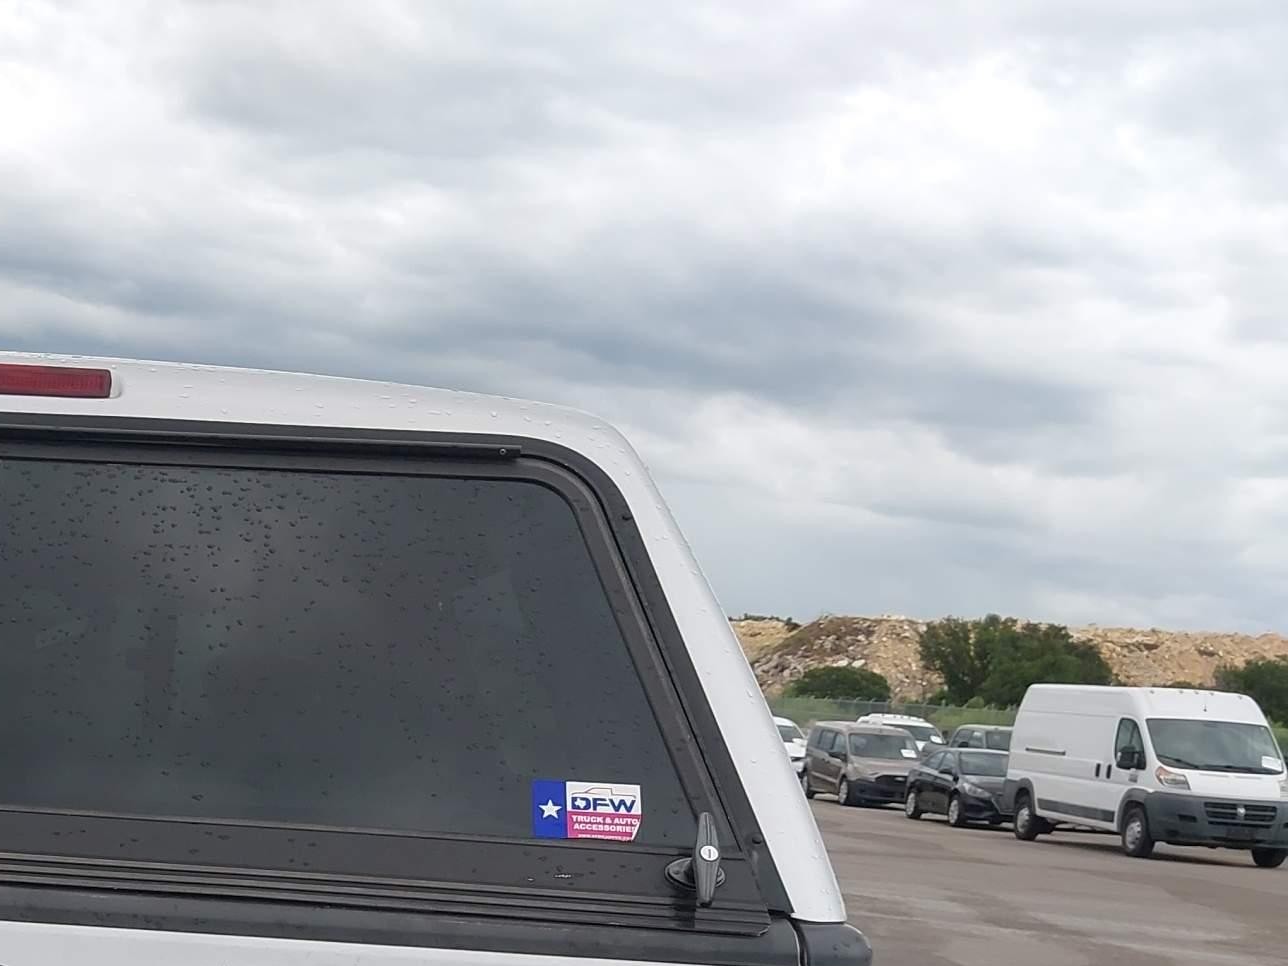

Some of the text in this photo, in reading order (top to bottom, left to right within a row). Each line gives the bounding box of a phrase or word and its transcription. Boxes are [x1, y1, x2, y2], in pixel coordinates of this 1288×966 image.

[571, 796, 636, 813] DFW
[572, 815, 603, 824] TRUCK
[605, 816, 612, 824] &
